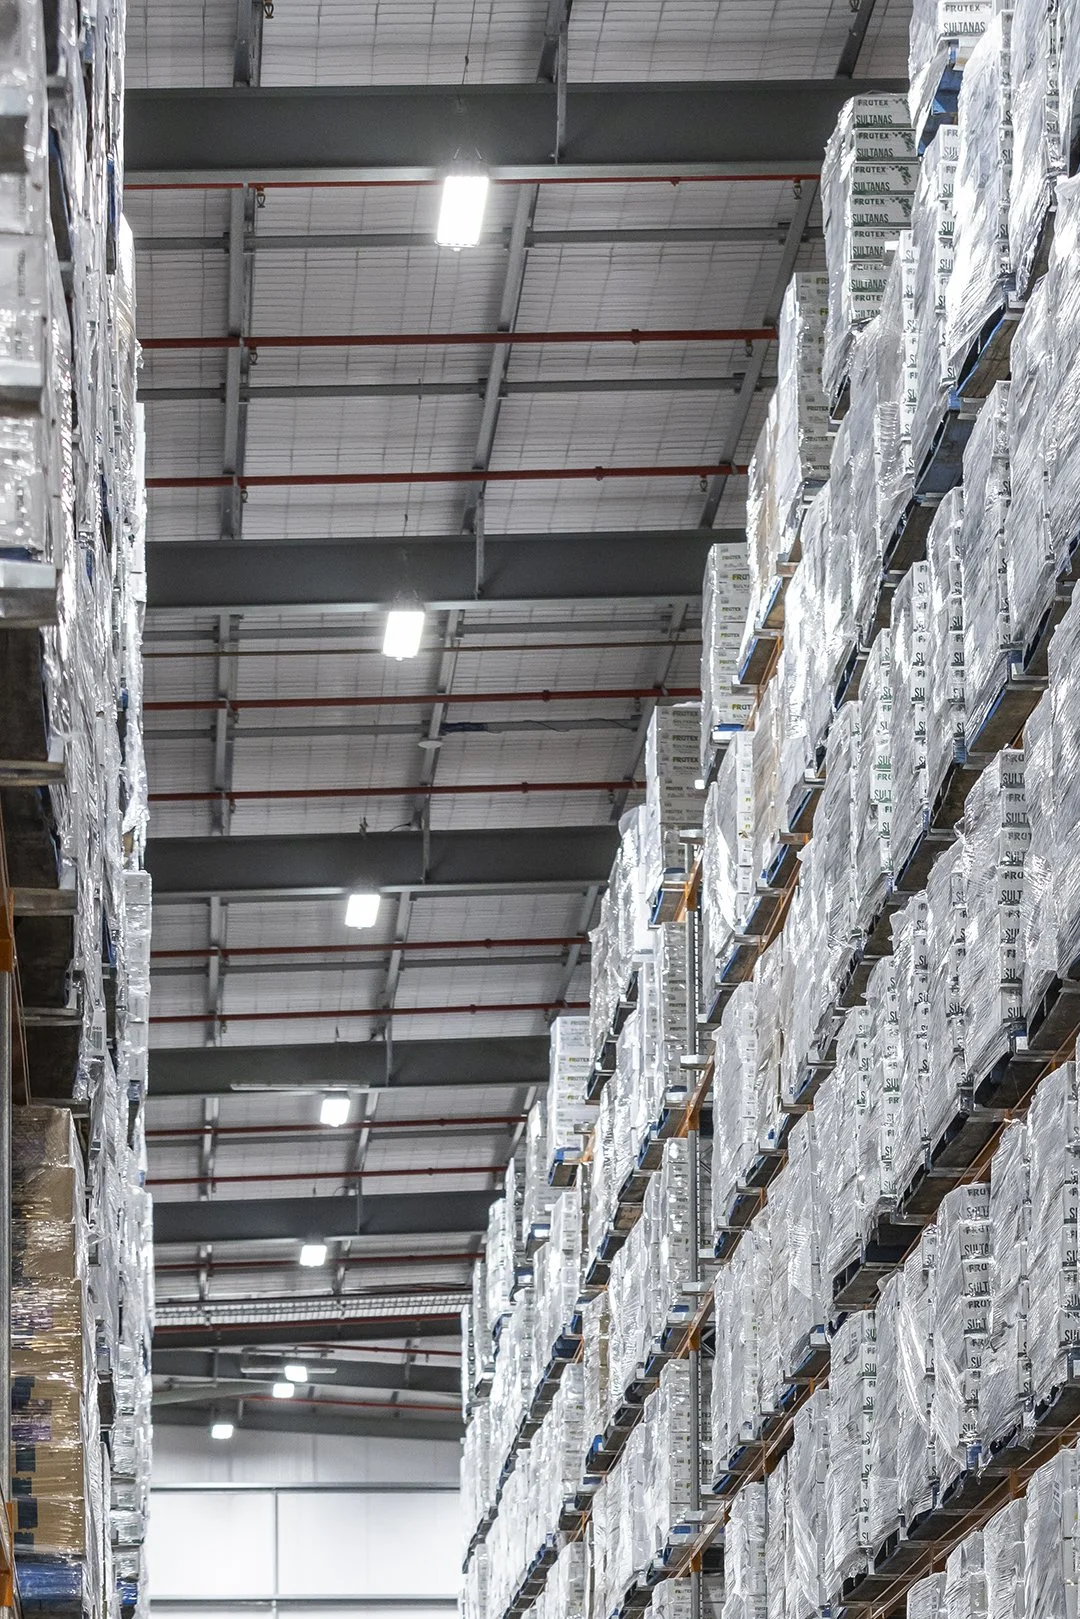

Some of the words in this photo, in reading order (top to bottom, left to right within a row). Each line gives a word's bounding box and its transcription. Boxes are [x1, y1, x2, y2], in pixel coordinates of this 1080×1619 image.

[943, 22, 986, 33] SULTANAS
[855, 114, 893, 125] SULTANAS
[856, 148, 894, 157] SULTANAS
[853, 181, 890, 191] SULTANAS
[852, 213, 889, 223] SULTANAS
[852, 246, 884, 256] SULTANA
[855, 294, 883, 302] FRUTE
[731, 703, 750, 711] FRUT
[1003, 773, 1025, 785] SULT
[1006, 812, 1028, 824] SULT
[1008, 832, 1031, 841] FRUT
[1004, 871, 1024, 880] FRU
[1002, 889, 1023, 901] SULT
[965, 1244, 989, 1255] SULTA
[968, 1264, 987, 1272] FRU
[968, 1281, 989, 1294] SULT
